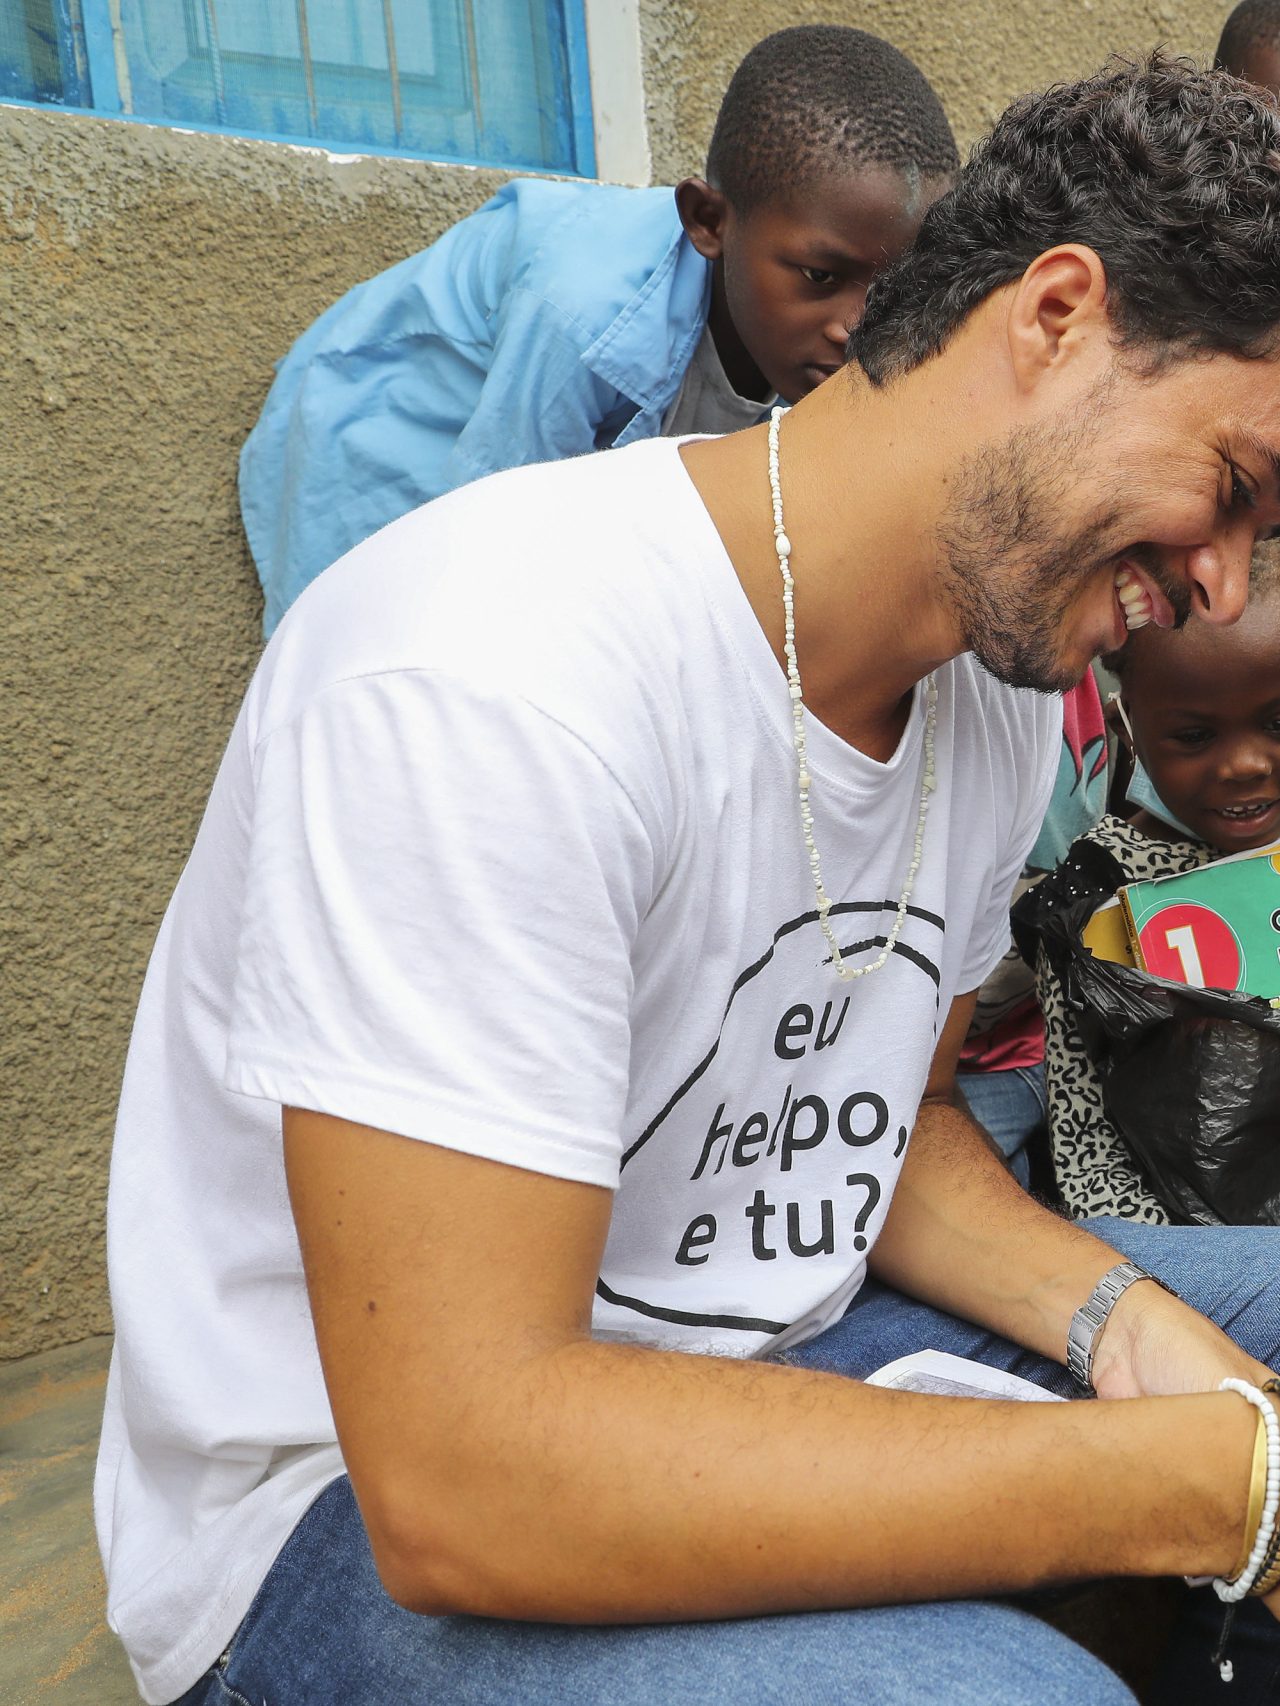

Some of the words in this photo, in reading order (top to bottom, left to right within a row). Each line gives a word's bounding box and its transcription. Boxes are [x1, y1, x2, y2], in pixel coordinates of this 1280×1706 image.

[1165, 924, 1206, 989] 1
[773, 996, 850, 1060] eu
[690, 1084, 907, 1181] helpo,
[674, 1213, 717, 1266] e
[745, 1173, 881, 1260] tu?
